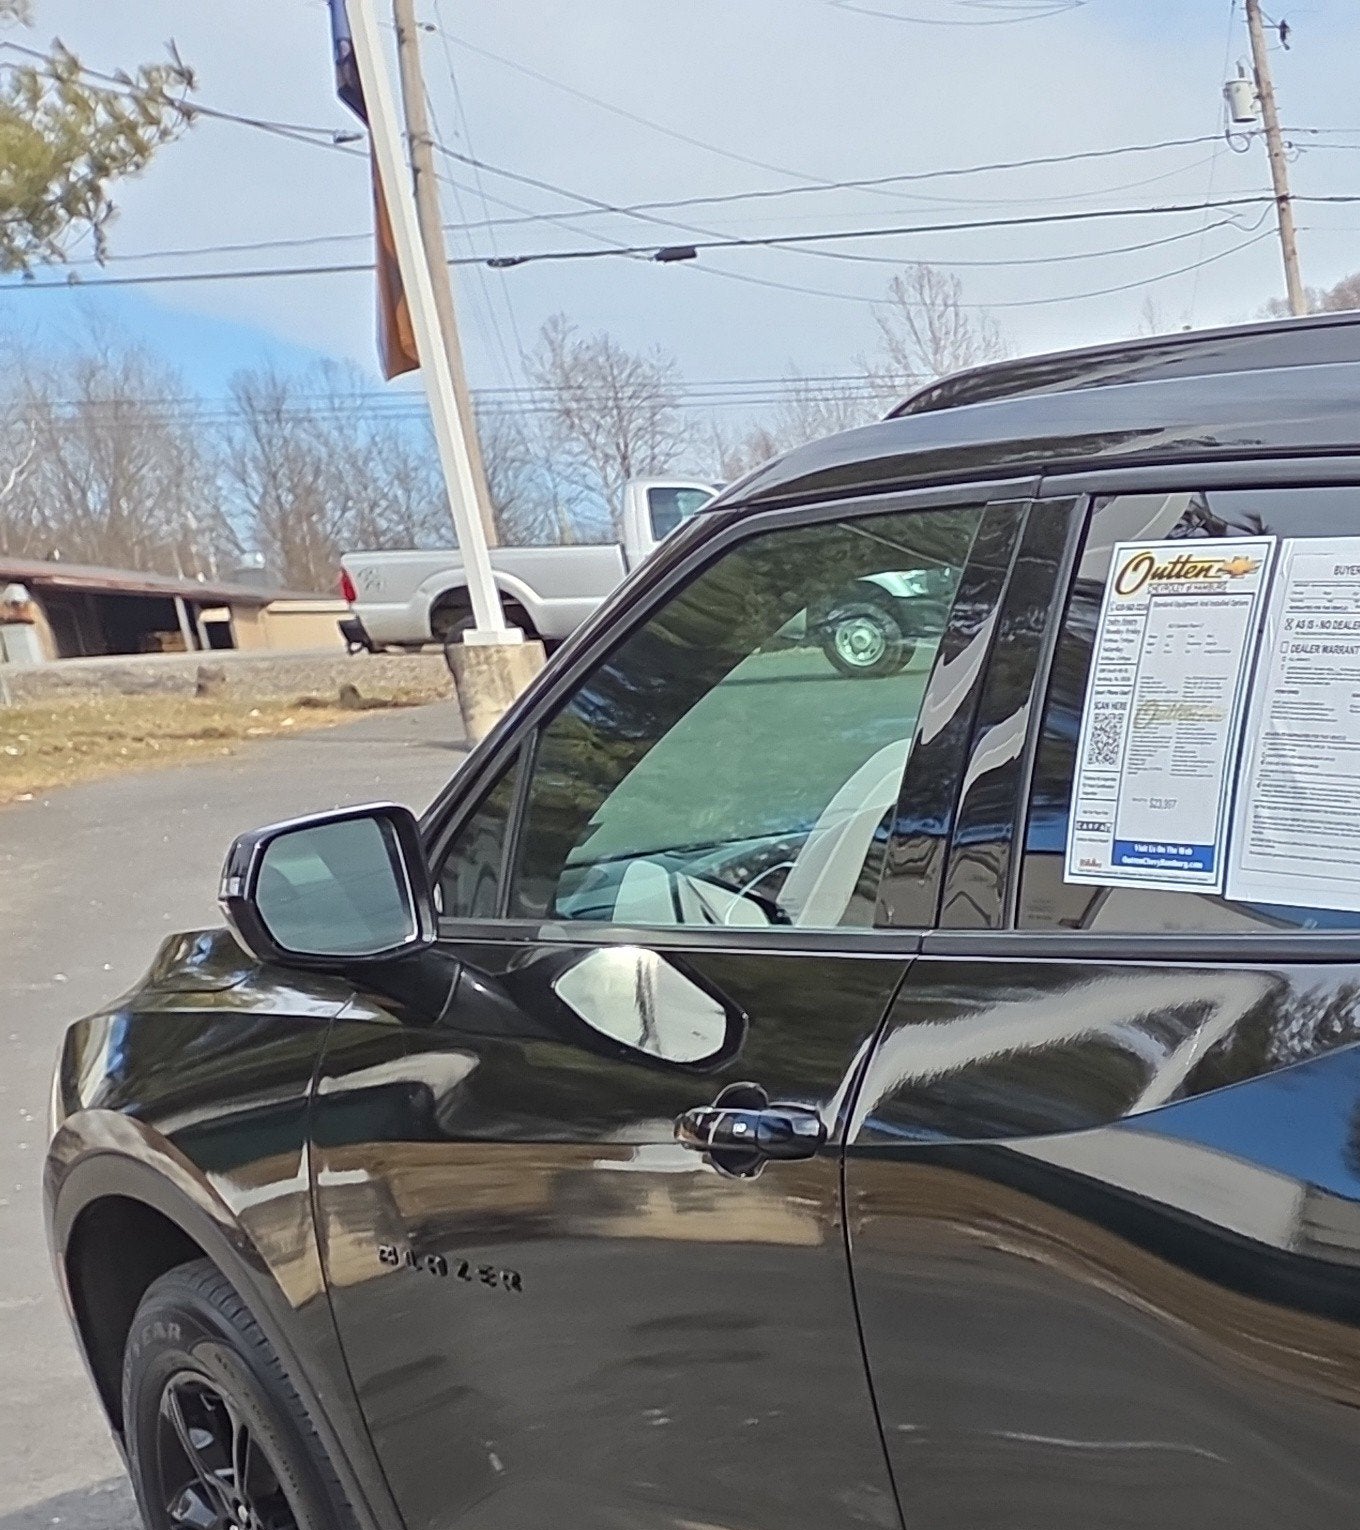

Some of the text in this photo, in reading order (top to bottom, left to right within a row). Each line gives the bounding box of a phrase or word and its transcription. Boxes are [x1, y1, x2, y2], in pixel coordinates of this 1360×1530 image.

[1115, 551, 1225, 596] Outten
[1295, 619, 1305, 629] AS
[1306, 619, 1314, 629] IS
[1320, 620, 1332, 629] NO
[1290, 644, 1321, 654] DEALER
[1094, 701, 1127, 711] SCAN HERE
[1134, 844, 1148, 852] Visit
[1167, 846, 1177, 854] The
[378, 1244, 523, 1293] BLAZER
